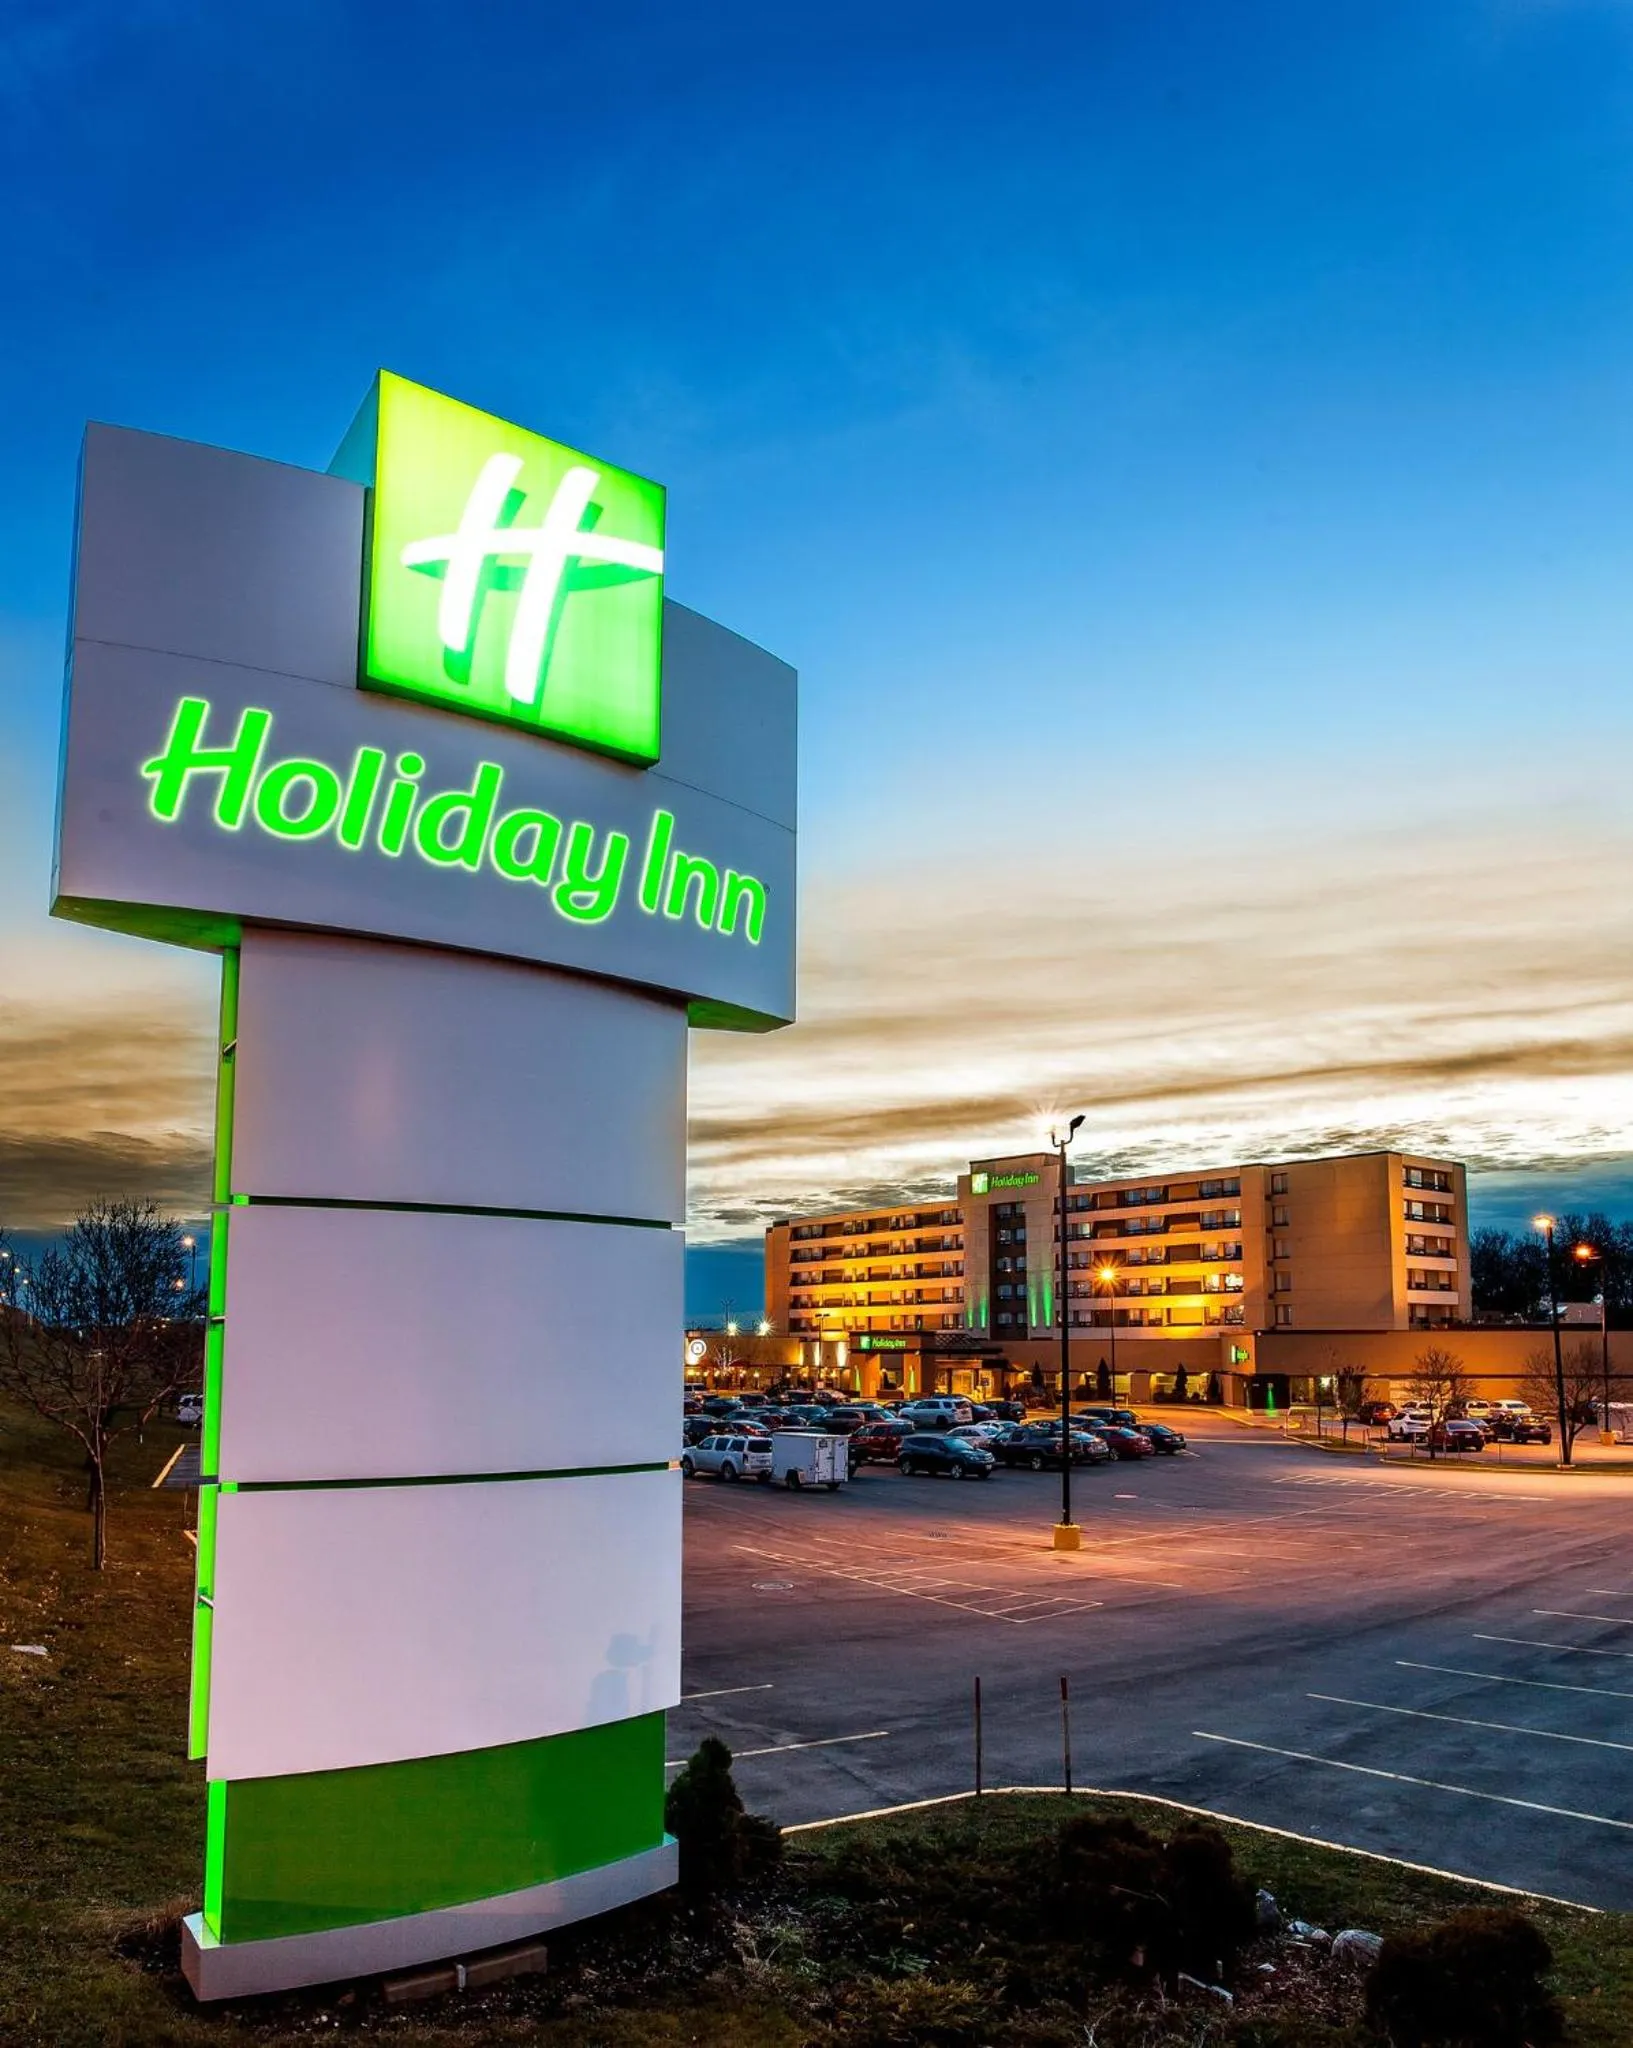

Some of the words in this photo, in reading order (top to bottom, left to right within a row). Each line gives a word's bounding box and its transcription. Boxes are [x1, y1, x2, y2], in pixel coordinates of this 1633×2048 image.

[141, 696, 629, 925] Holiday
[636, 808, 767, 945] Inn
[991, 1175, 1024, 1188] Holiday
[1025, 1173, 1039, 1184] Inn
